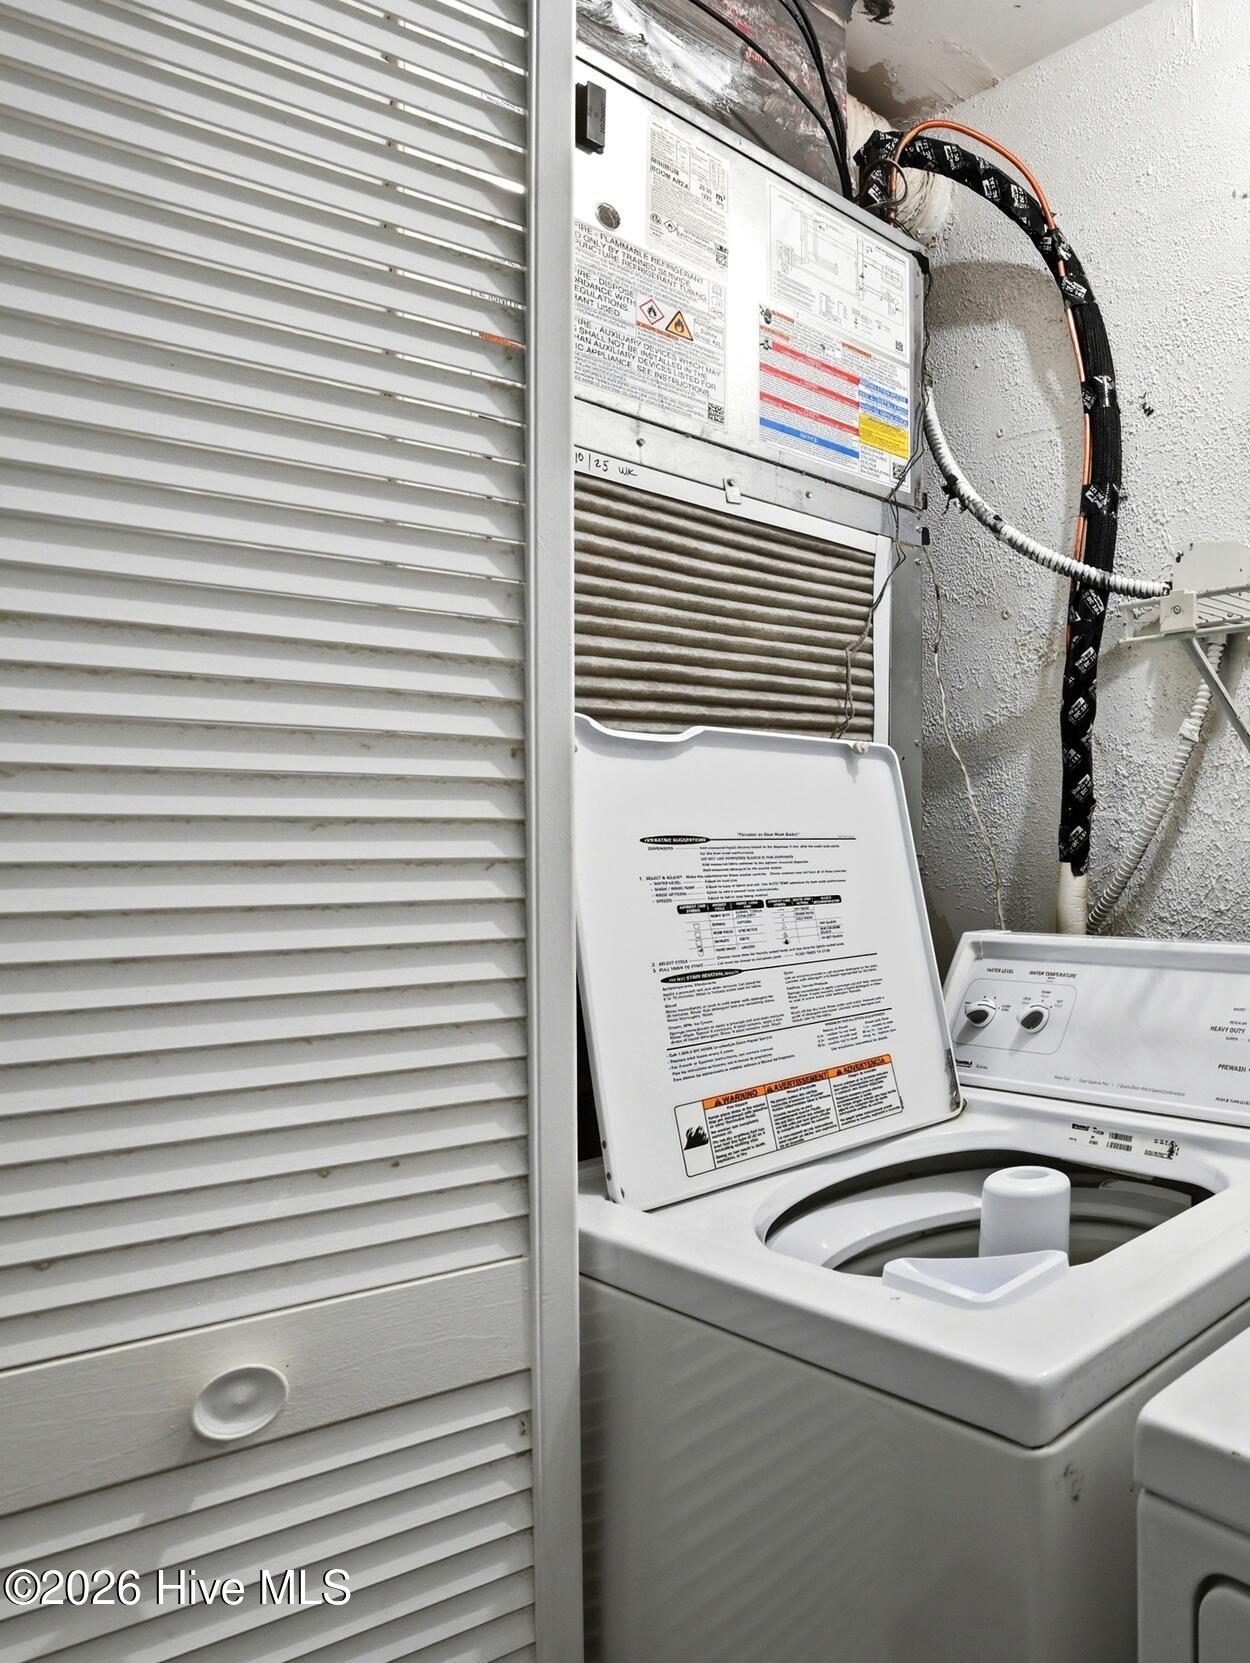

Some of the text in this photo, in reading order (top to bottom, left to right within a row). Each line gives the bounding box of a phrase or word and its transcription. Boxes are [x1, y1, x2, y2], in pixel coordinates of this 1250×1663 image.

[583, 234, 690, 287] ONLY BY TRAINED SERVICE
[600, 233, 648, 260] FLAMMABLE
[599, 278, 636, 298] DISPOSE
[614, 292, 637, 306] WITH
[580, 326, 606, 343] SHALL
[608, 338, 625, 350] NOT
[627, 345, 638, 354] BE
[640, 349, 682, 370] INSTALLED
[694, 370, 707, 380] THE
[593, 341, 635, 360] AUXILIARY
[638, 356, 672, 374] DEVICES
[673, 370, 700, 385] LISTED
[701, 379, 717, 391] FOR
[599, 326, 642, 347] AUXILIARY
[643, 344, 678, 361] DEVICES
[679, 357, 704, 371] WHICH
[722, 1058, 885, 1105] WARNING AVERTISSEMENT ADVERTENCIA
[1218, 1064, 1247, 1073] PREWASH
